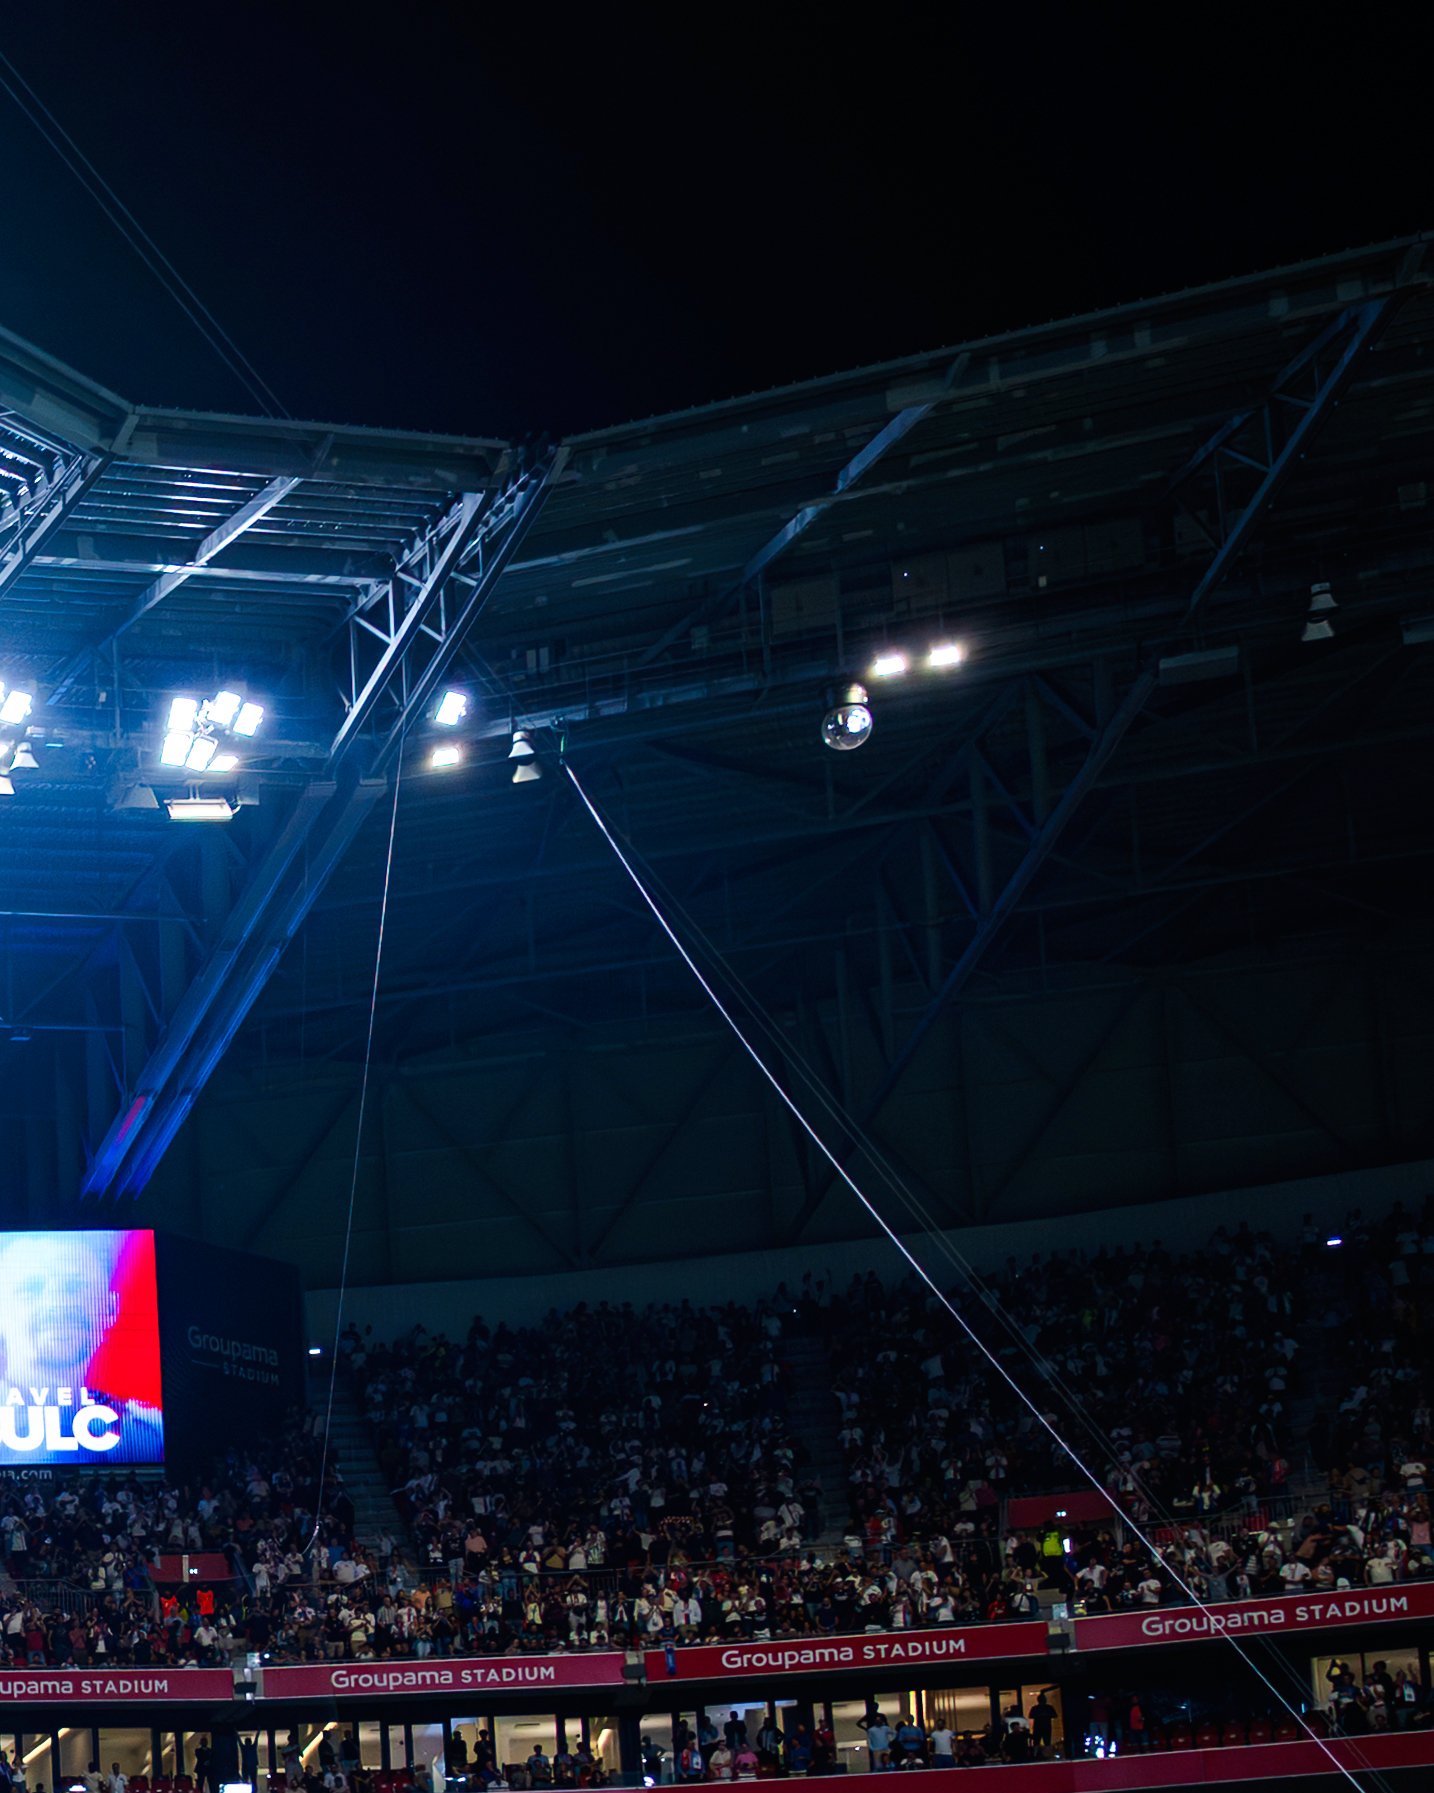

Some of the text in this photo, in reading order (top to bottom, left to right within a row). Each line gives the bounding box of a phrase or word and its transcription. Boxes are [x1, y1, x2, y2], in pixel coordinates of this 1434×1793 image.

[187, 1325, 279, 1367] Groupama
[1142, 1595, 1409, 1639] Groupama STADIUM
[720, 1637, 967, 1675] Groupama STADIUM
[80, 1676, 170, 1695] STADIUM
[330, 1664, 556, 1694] Groupama STADIUM
